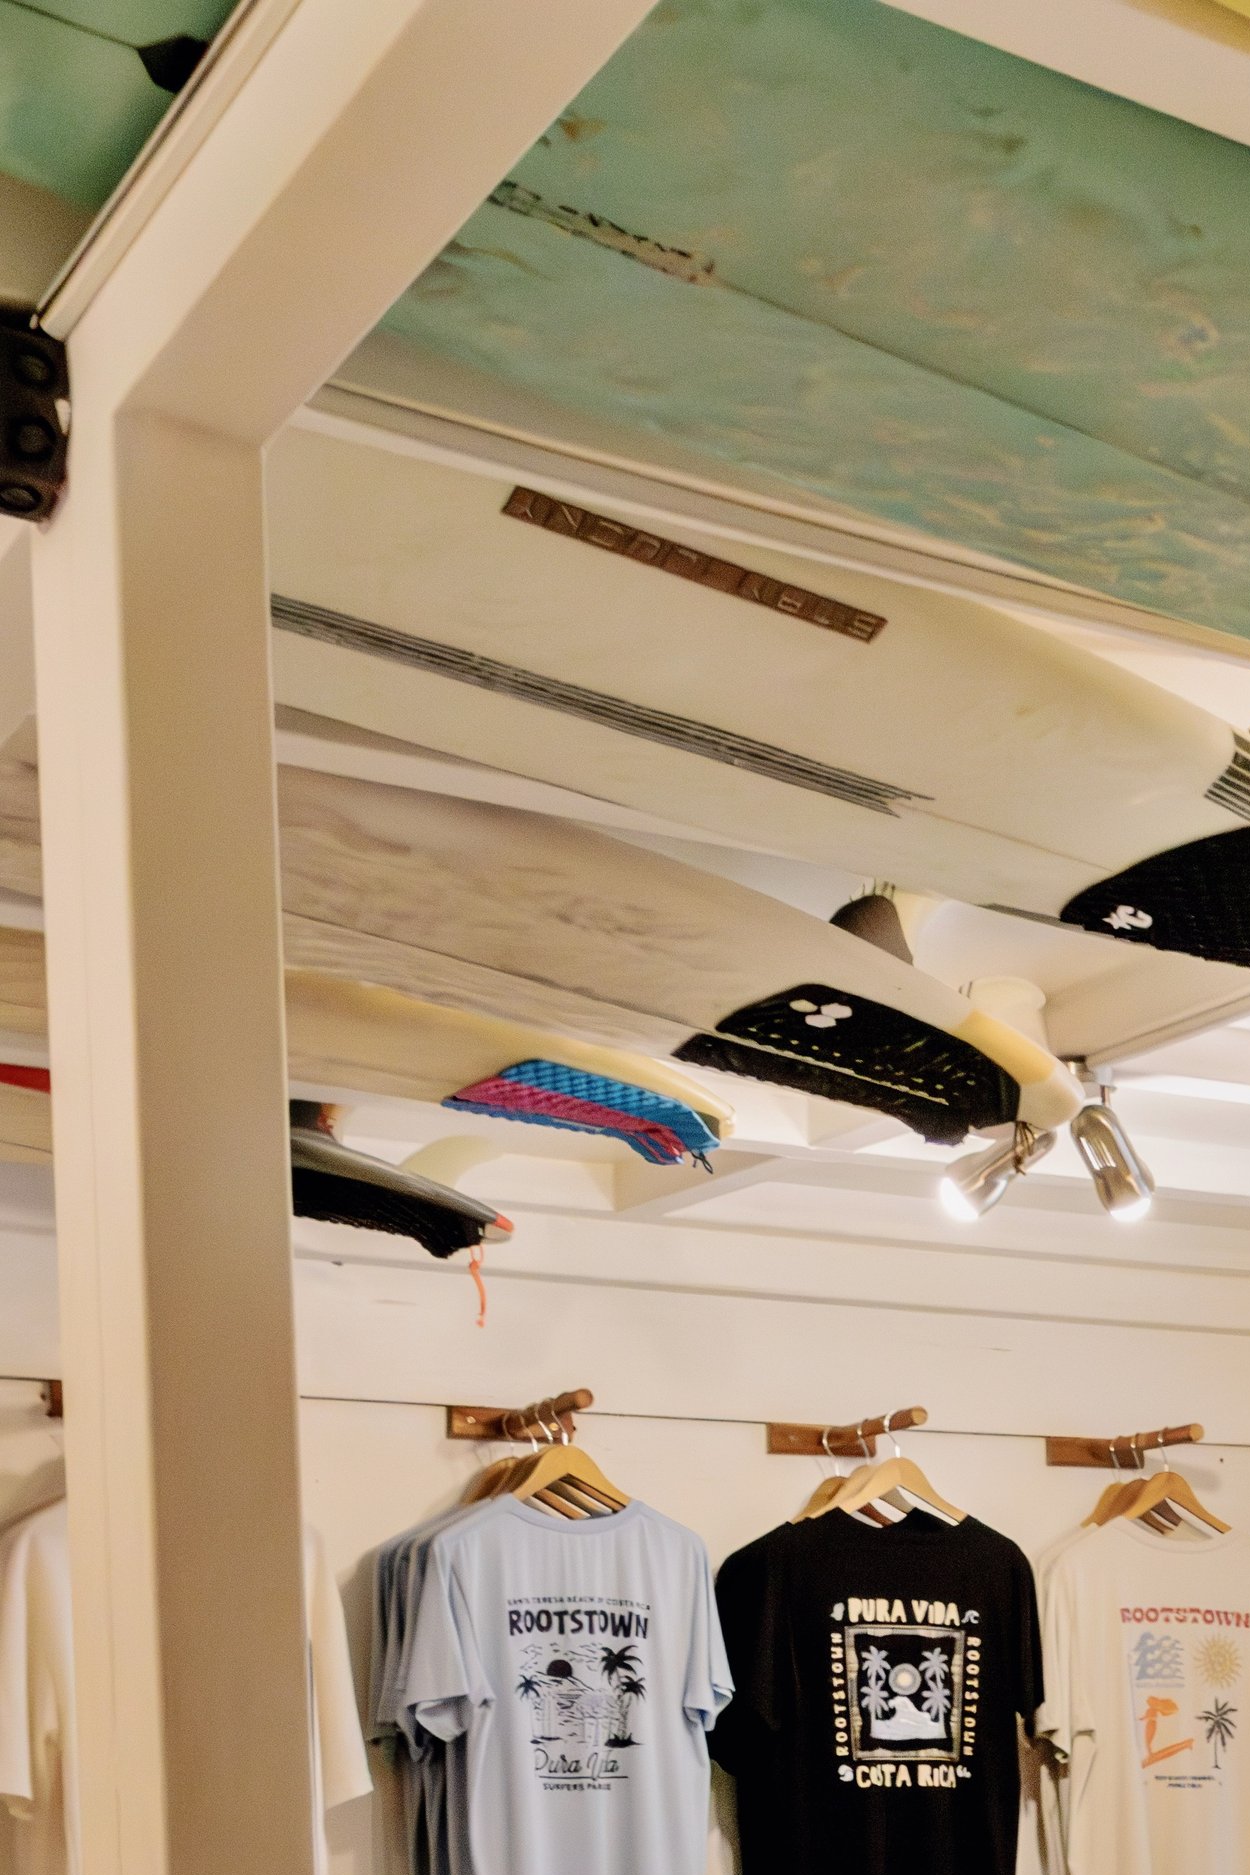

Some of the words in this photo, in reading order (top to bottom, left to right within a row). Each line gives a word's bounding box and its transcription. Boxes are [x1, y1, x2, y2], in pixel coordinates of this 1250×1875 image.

[508, 1609, 649, 1640] ROOTSTOWN
[848, 1598, 907, 1623] PURA
[1119, 1607, 1250, 1628] ROOTSTOWN
[830, 1633, 850, 1756] ROOTSTOWN
[963, 1636, 982, 1756] ROOTSTOWN
[917, 1764, 957, 1789] RICA
